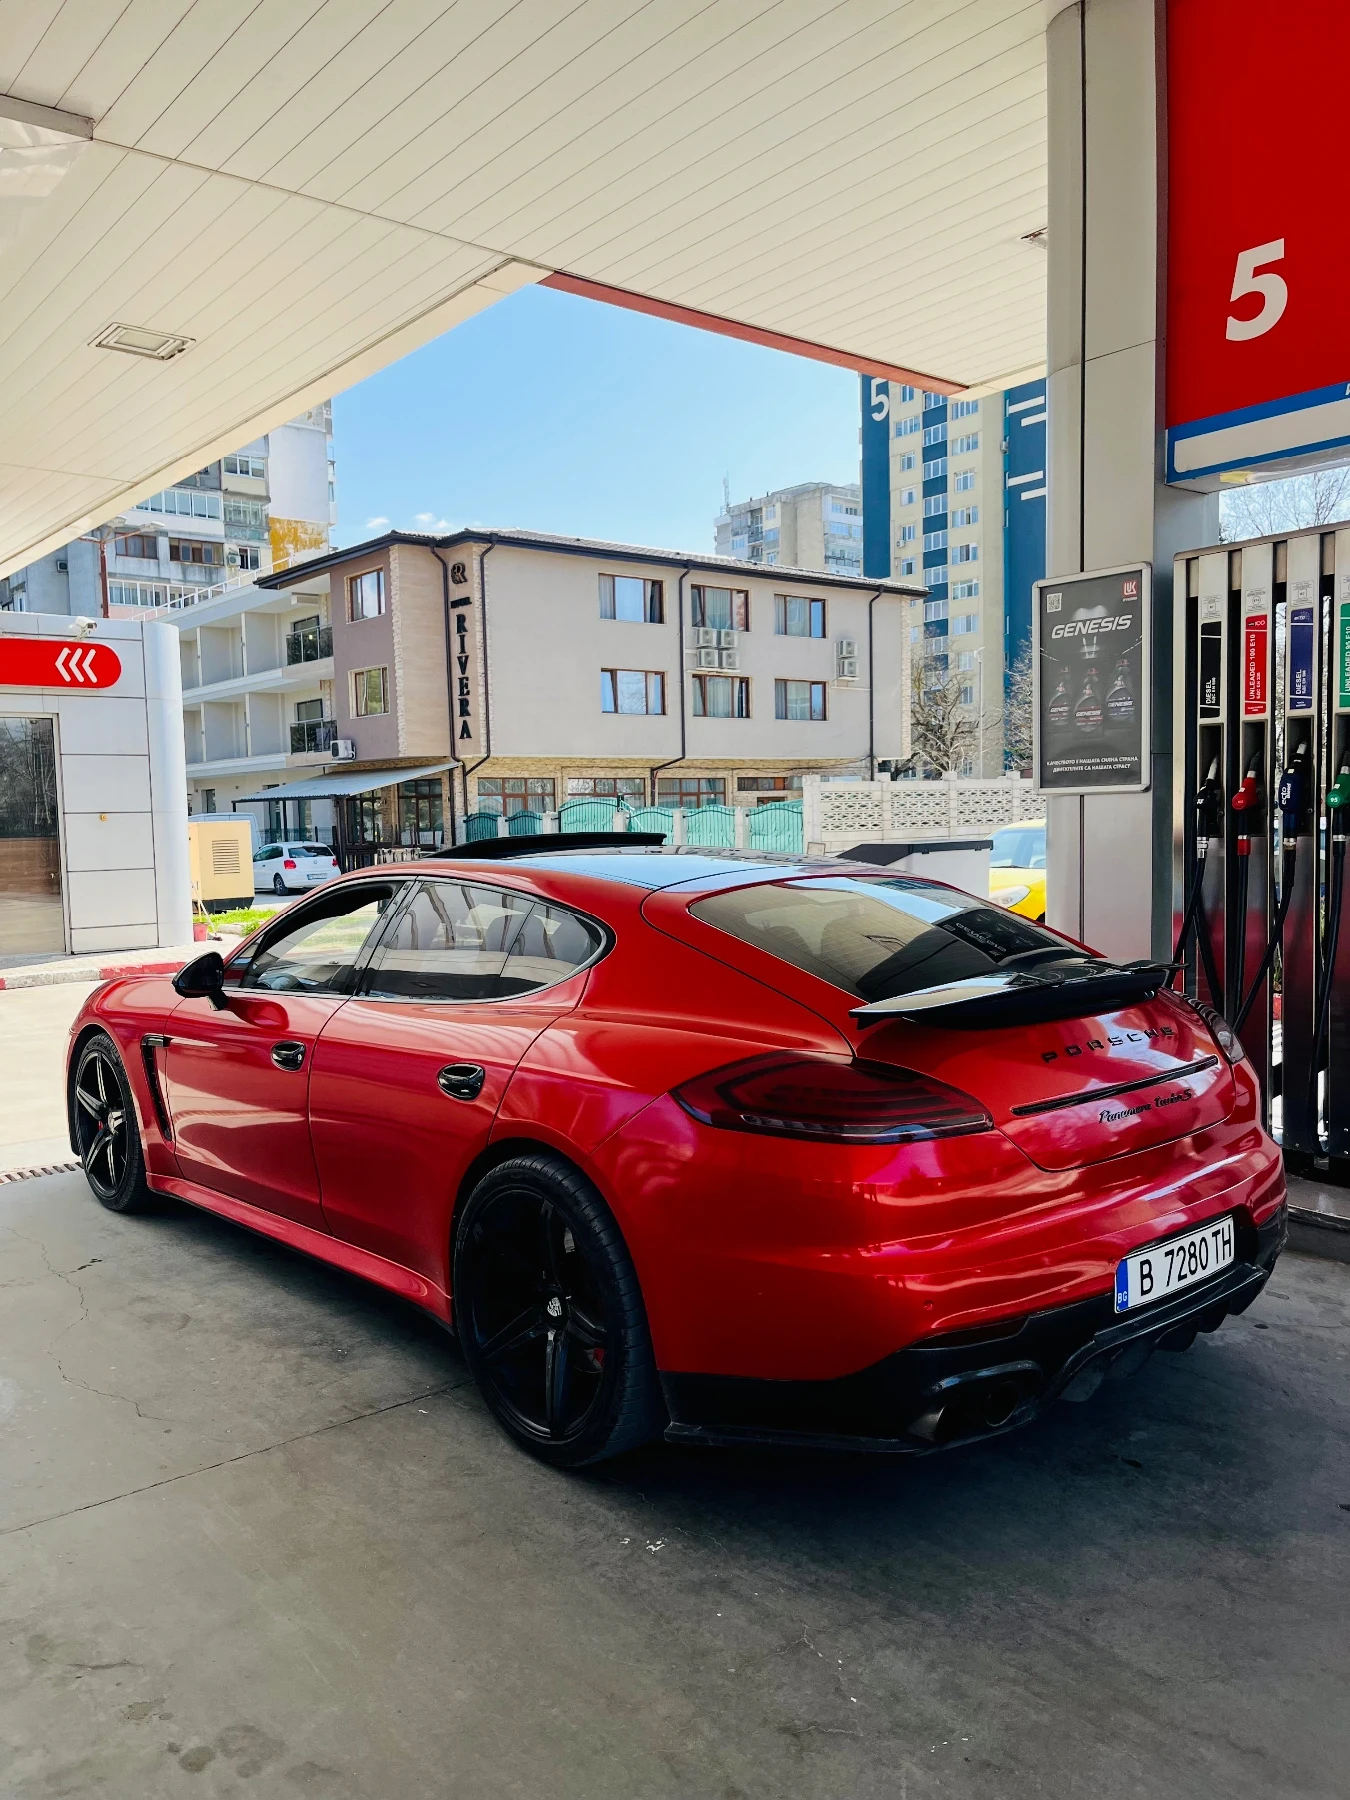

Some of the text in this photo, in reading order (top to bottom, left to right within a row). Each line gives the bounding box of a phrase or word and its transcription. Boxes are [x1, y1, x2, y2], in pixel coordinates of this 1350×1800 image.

[1226, 238, 1288, 342] 5
[870, 377, 890, 422] 5
[1051, 614, 1133, 639] GENESIS
[456, 613, 472, 740] RIVERA
[1041, 1026, 1175, 1063] PORSCHE
[1098, 1102, 1152, 1124] Panamera
[1139, 1224, 1232, 1297] B 7280 TH
[1117, 1290, 1128, 1304] BG
